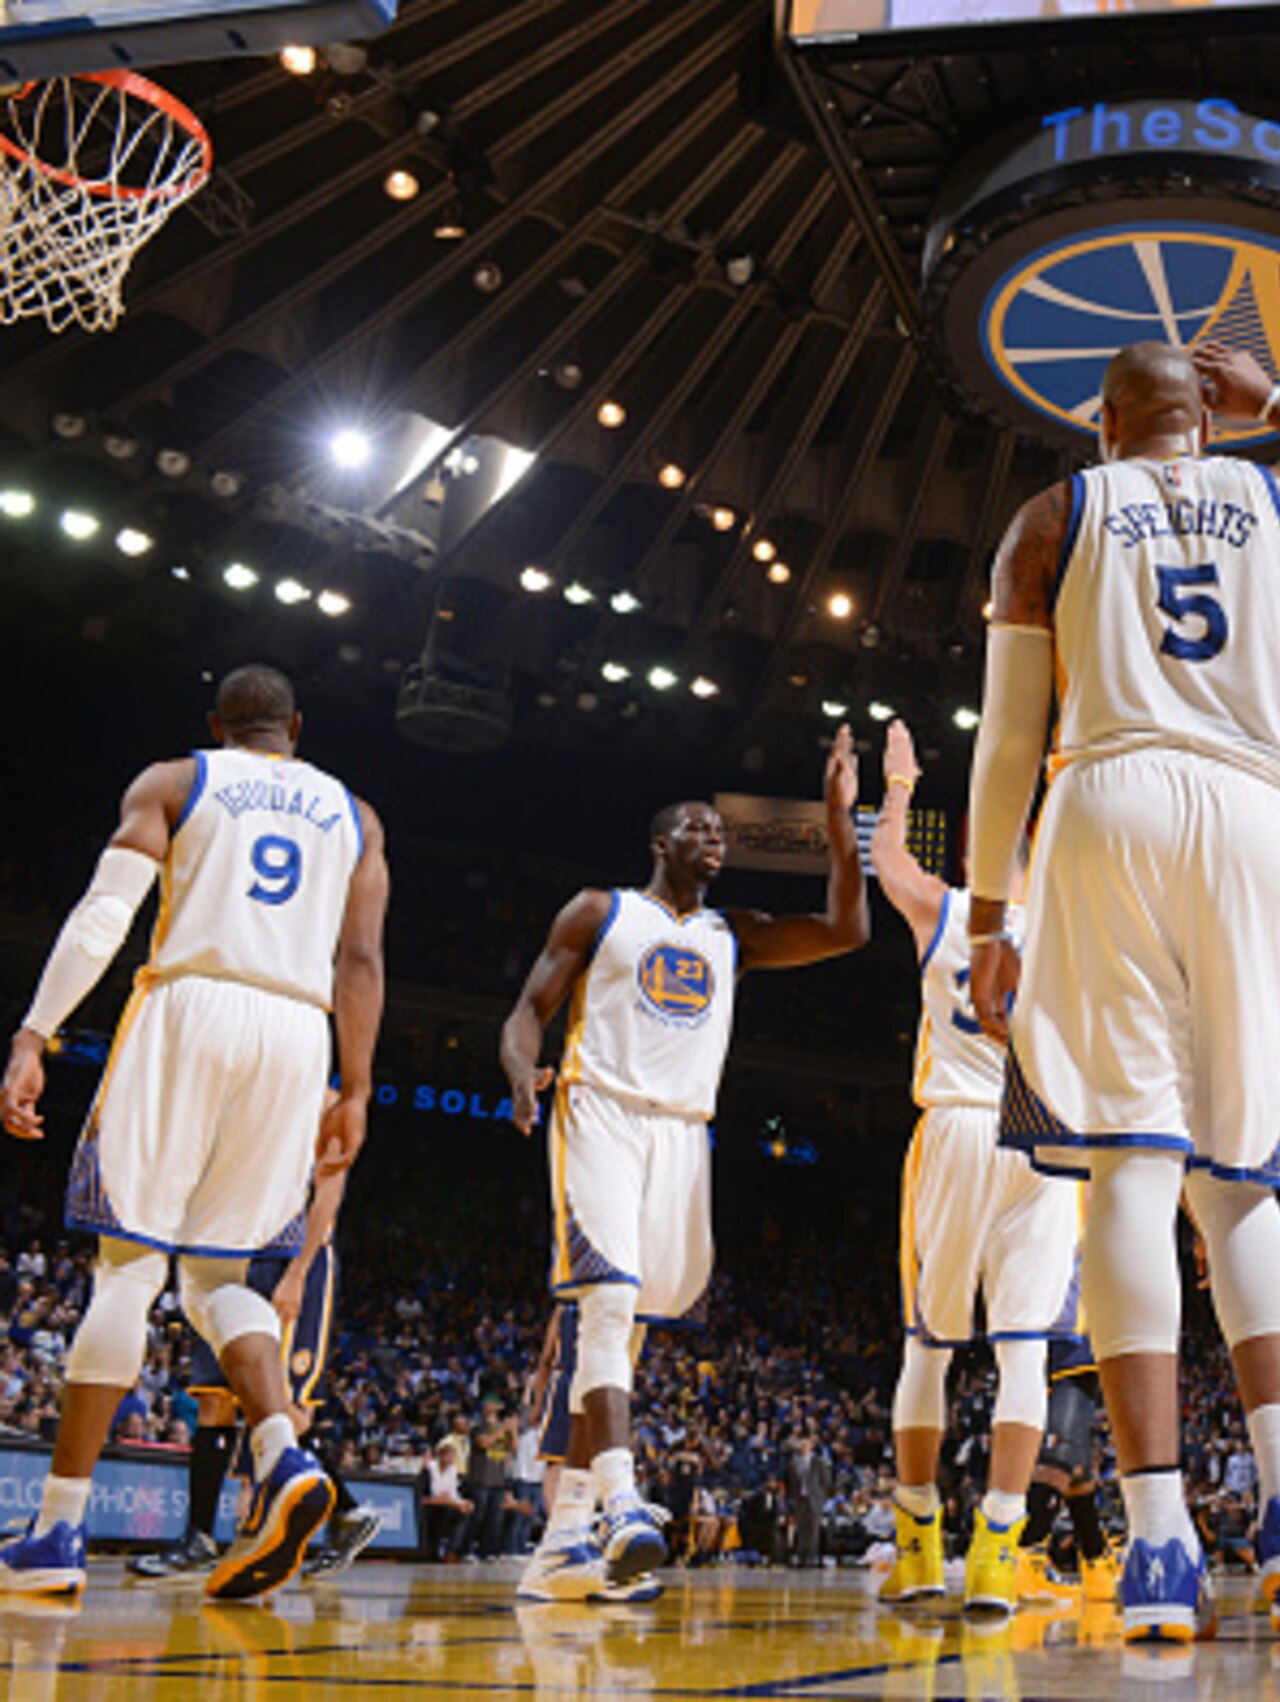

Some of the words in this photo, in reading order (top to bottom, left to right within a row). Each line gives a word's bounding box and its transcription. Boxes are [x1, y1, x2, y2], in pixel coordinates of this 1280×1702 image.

[1155, 562, 1229, 662] 5
[246, 833, 302, 905] 9
[413, 1084, 544, 1126] SOLA
